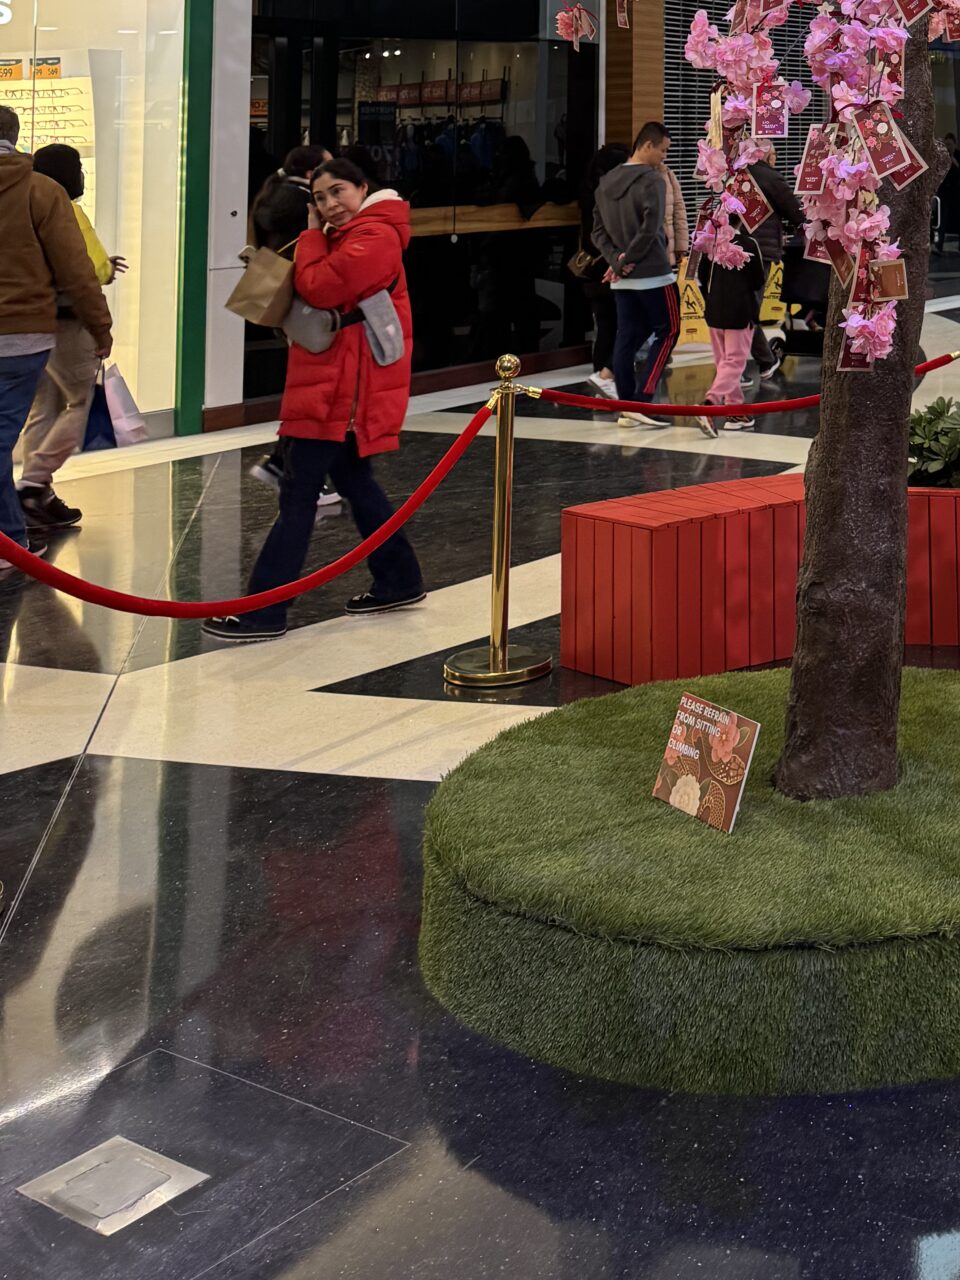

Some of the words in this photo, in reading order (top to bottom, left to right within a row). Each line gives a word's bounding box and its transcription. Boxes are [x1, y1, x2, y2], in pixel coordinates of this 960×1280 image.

[680, 696, 706, 714] PLEASE
[703, 707, 730, 725] REFRAIN
[671, 725, 682, 736] OR
[676, 712, 695, 726] FROM
[695, 720, 721, 737] SITTING
[668, 739, 700, 760] CLIMBING
